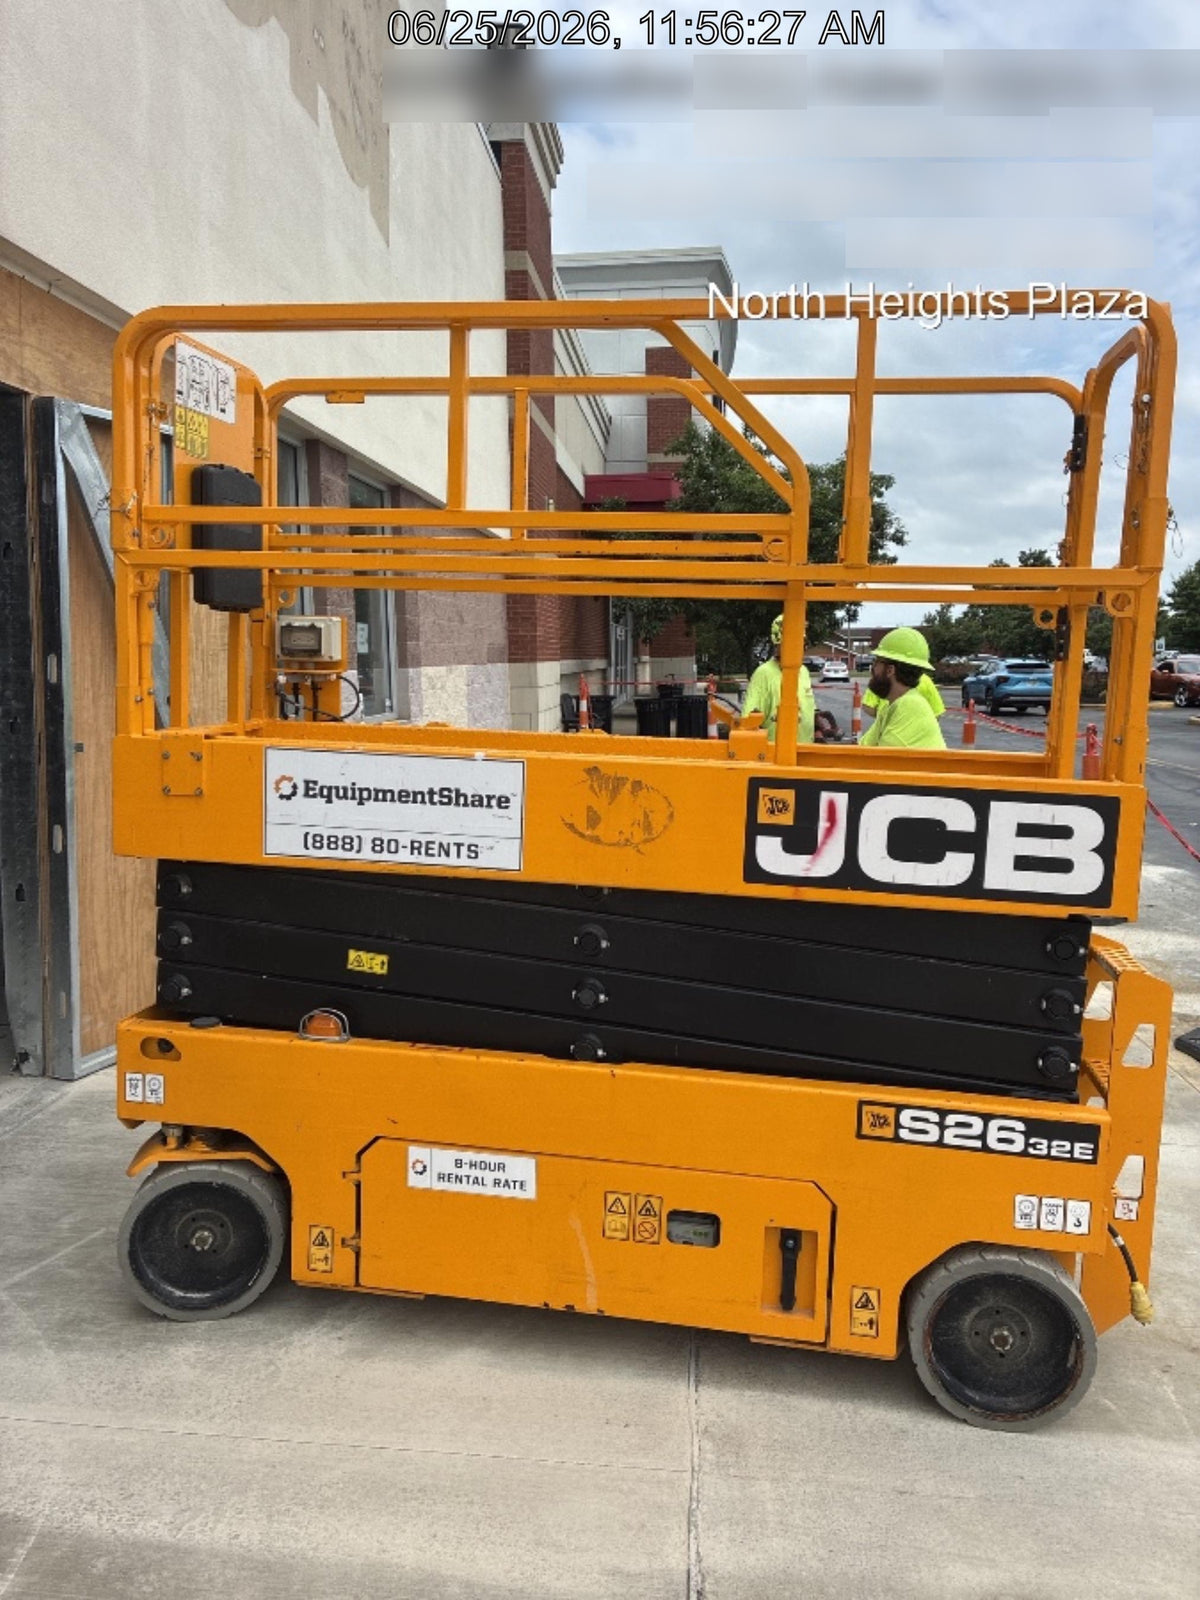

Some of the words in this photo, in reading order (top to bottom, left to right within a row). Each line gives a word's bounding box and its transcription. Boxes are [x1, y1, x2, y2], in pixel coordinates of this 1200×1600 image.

[303, 779, 511, 810] EquipmentShare
[303, 832, 363, 854] (888)
[371, 837, 480, 860] 80-RENTS
[755, 791, 1105, 895] JCB
[437, 1172, 487, 1187] RENTAL
[493, 1177, 527, 1191] RATE
